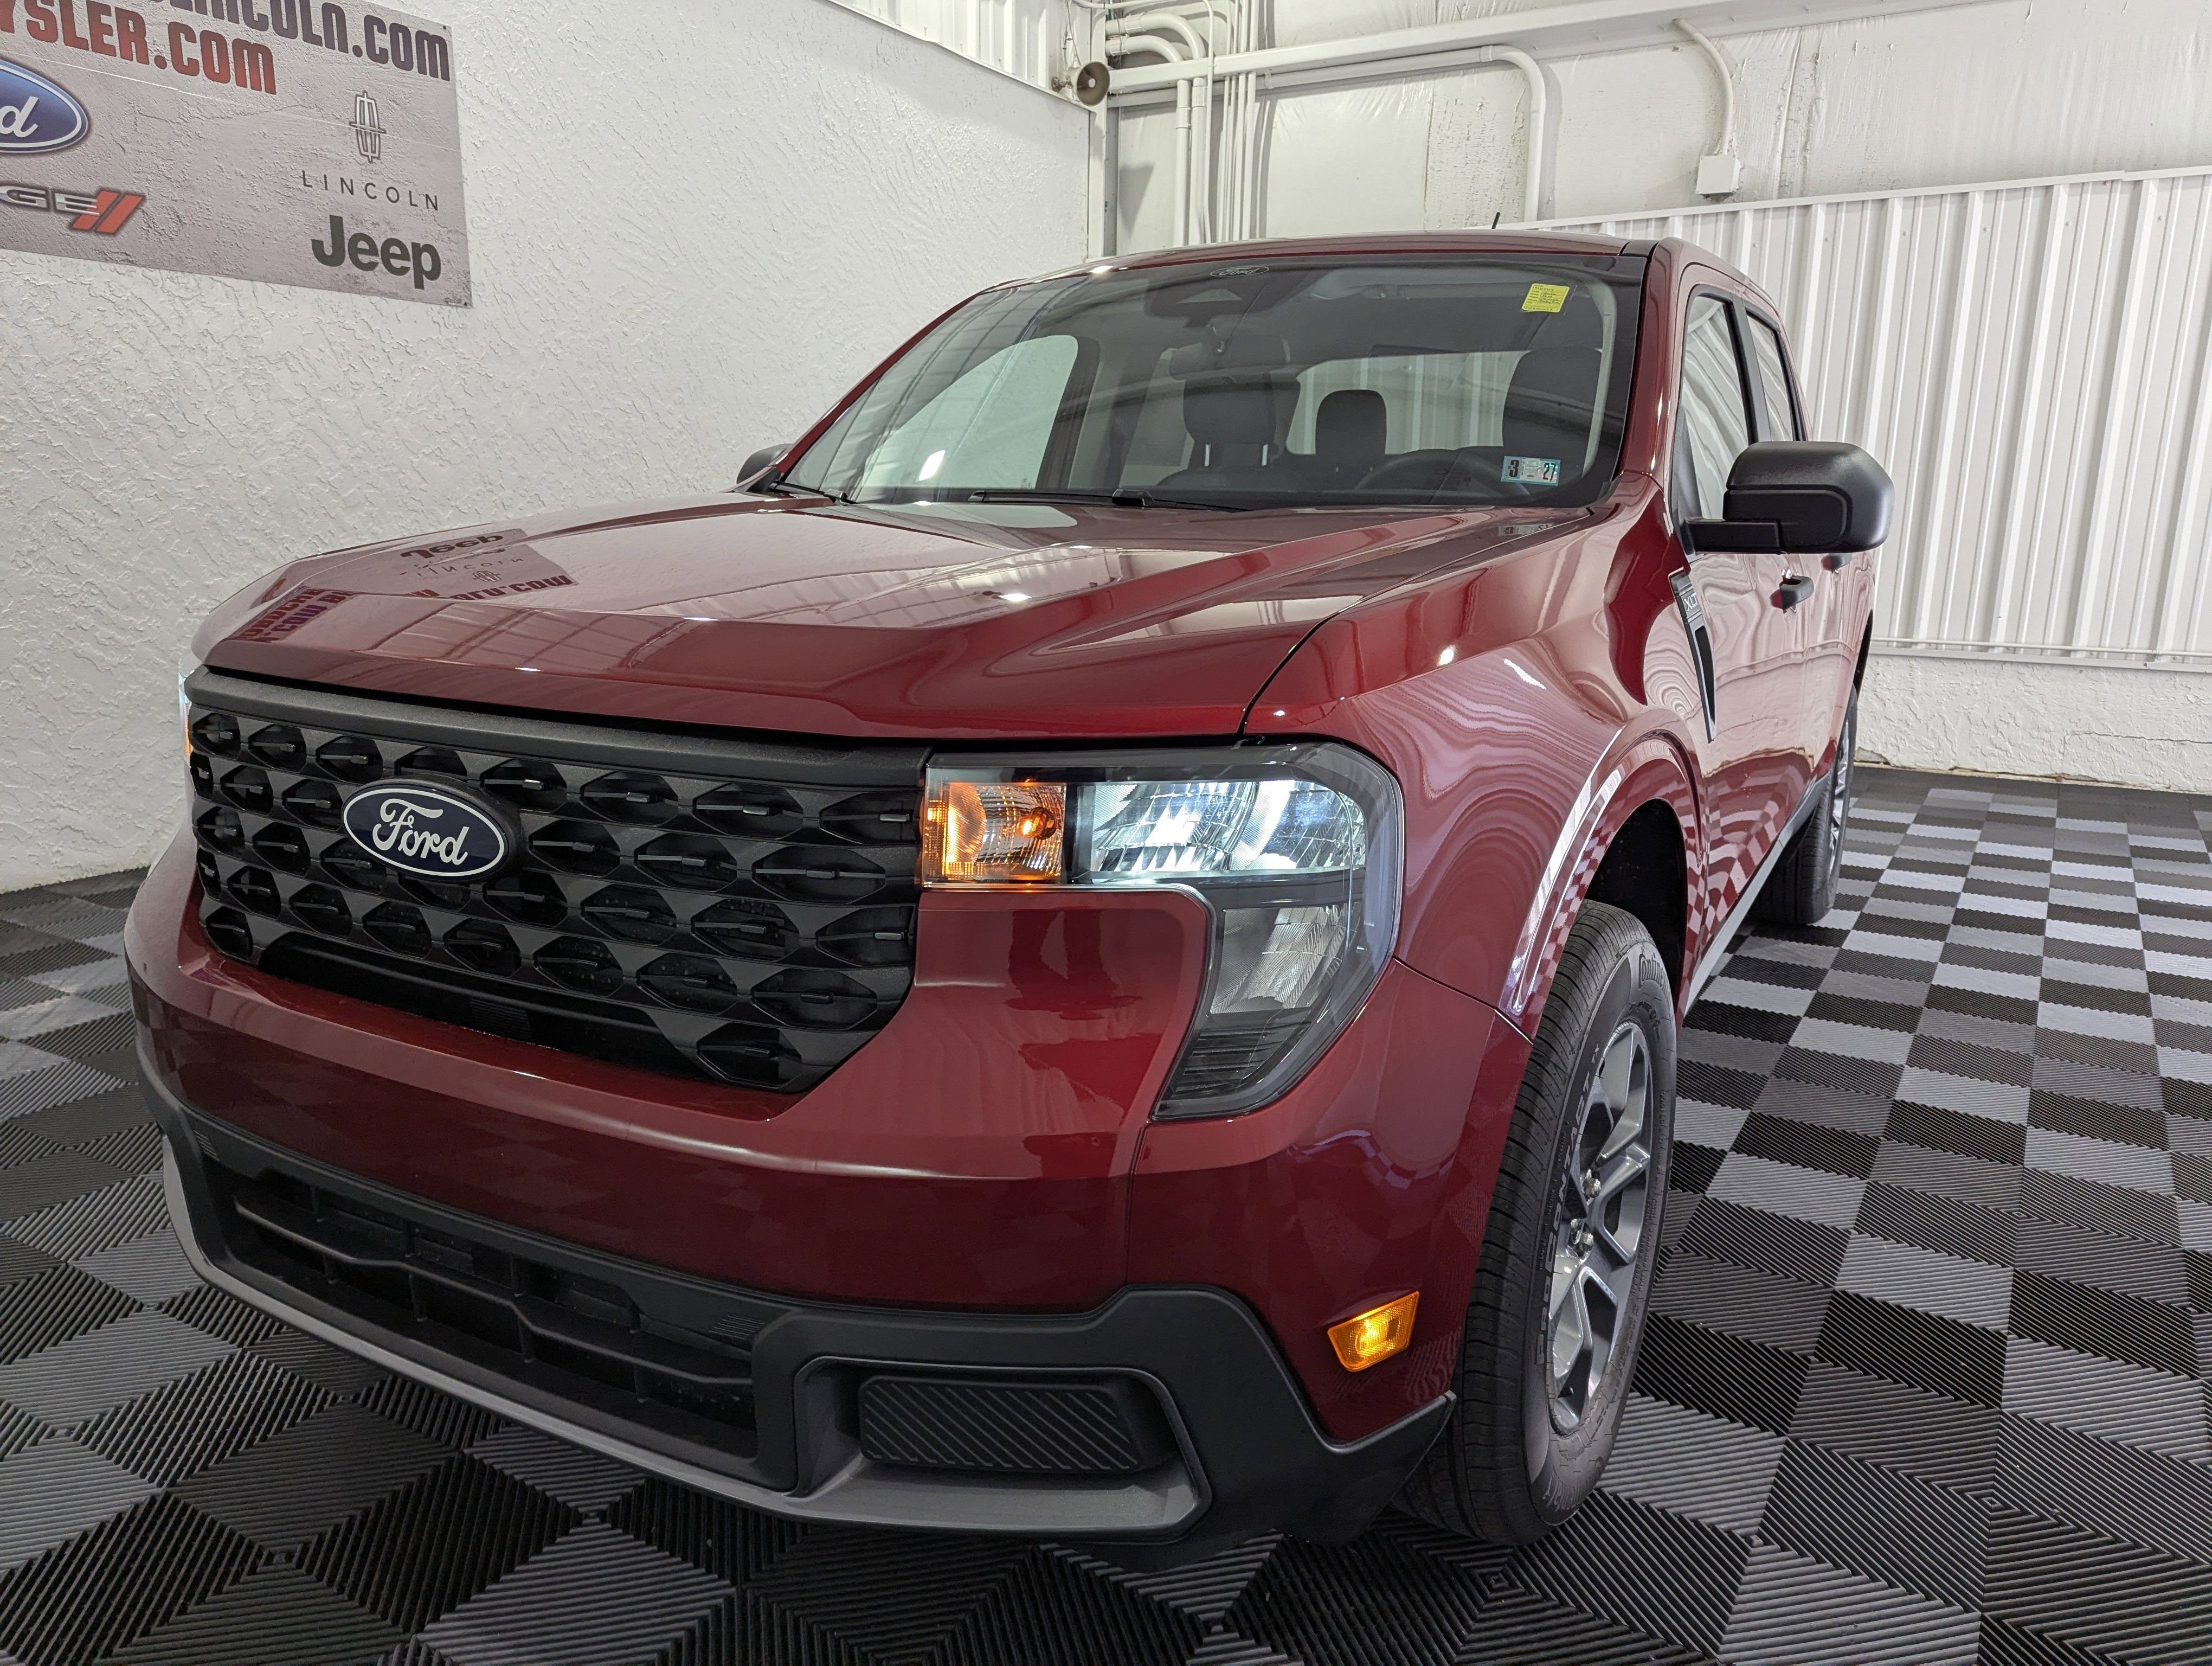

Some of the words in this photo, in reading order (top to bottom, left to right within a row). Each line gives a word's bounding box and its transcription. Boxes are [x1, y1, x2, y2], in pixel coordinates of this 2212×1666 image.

[170, 0, 451, 81] COLN.COM
[301, 170, 438, 211] LINCOLN
[311, 214, 441, 290] Jeep
[1218, 266, 1259, 276] Ford
[1509, 459, 1520, 477] 3
[1542, 462, 1557, 481] 27
[372, 798, 470, 866] Ford
